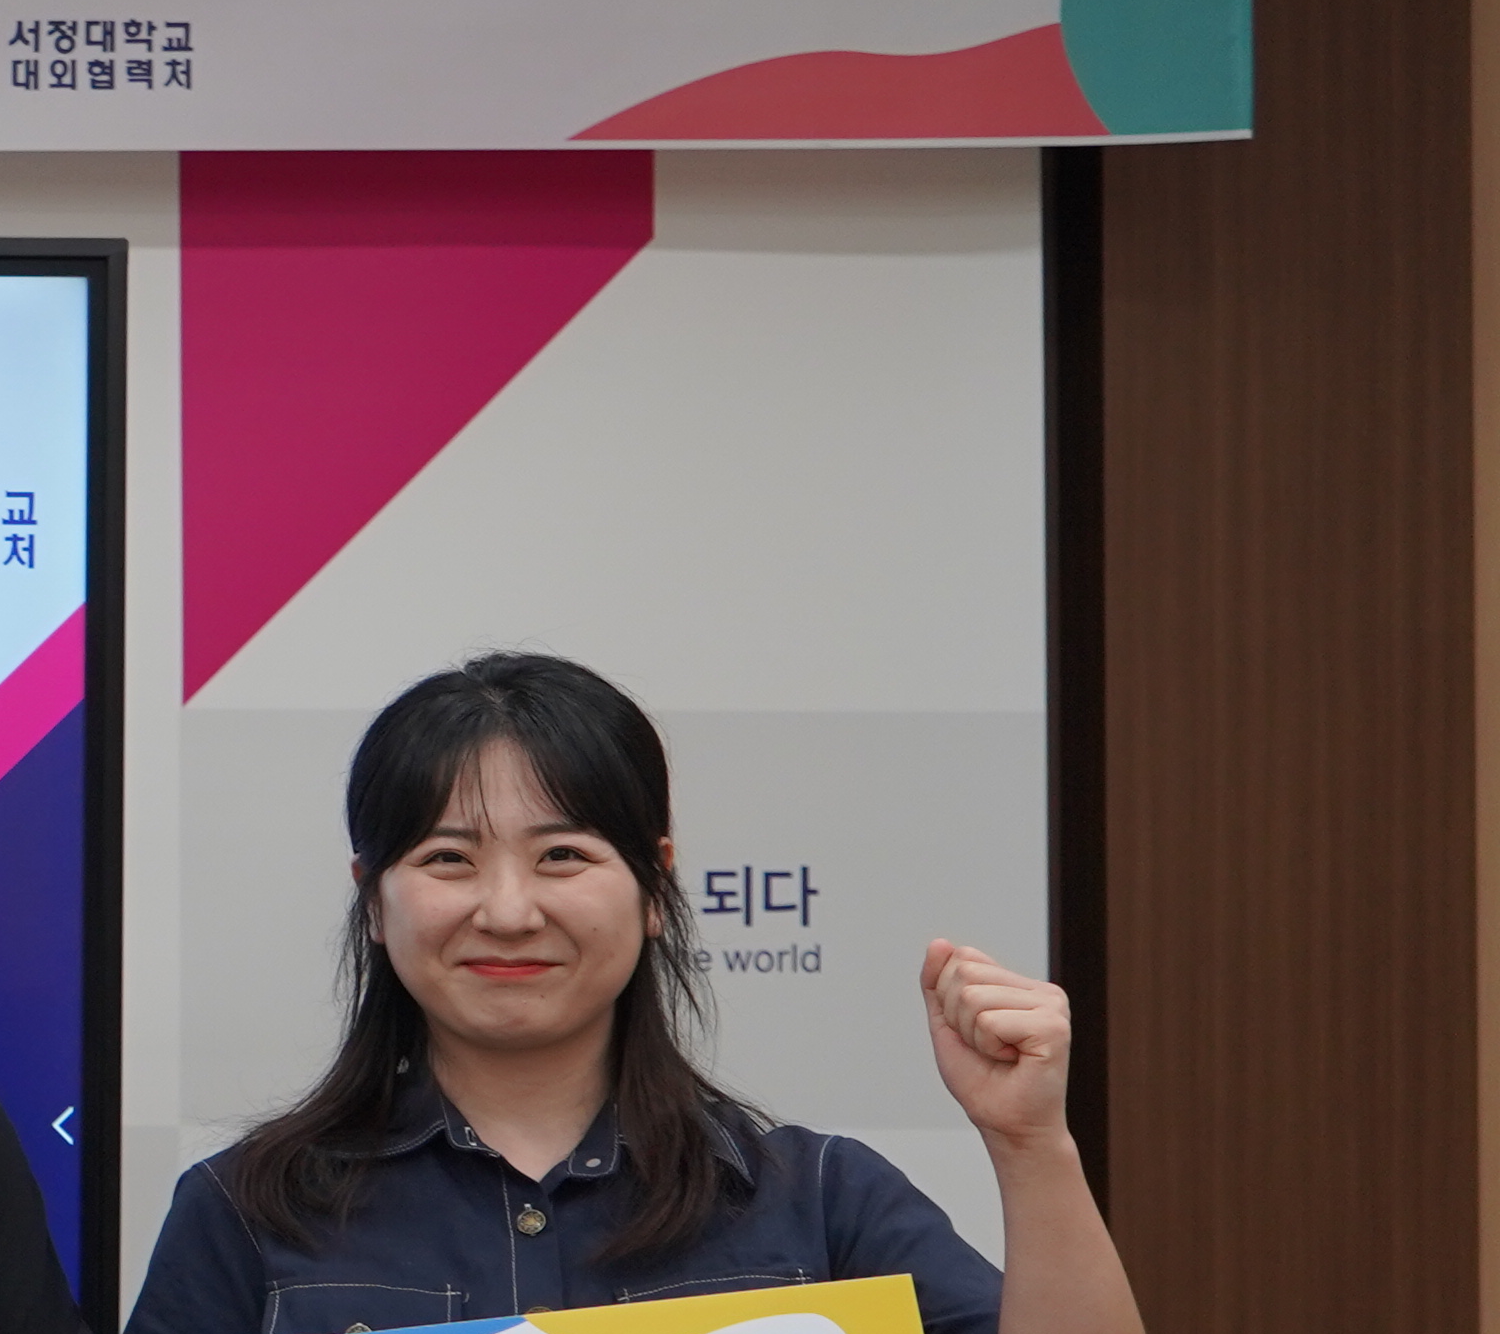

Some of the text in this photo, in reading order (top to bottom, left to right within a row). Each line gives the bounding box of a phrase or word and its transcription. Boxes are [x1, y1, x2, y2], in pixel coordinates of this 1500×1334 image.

[8, 18, 194, 55] 서정대학교
[11, 58, 192, 91] 대외협력처
[701, 864, 821, 928] 되다
[723, 943, 822, 974] world
